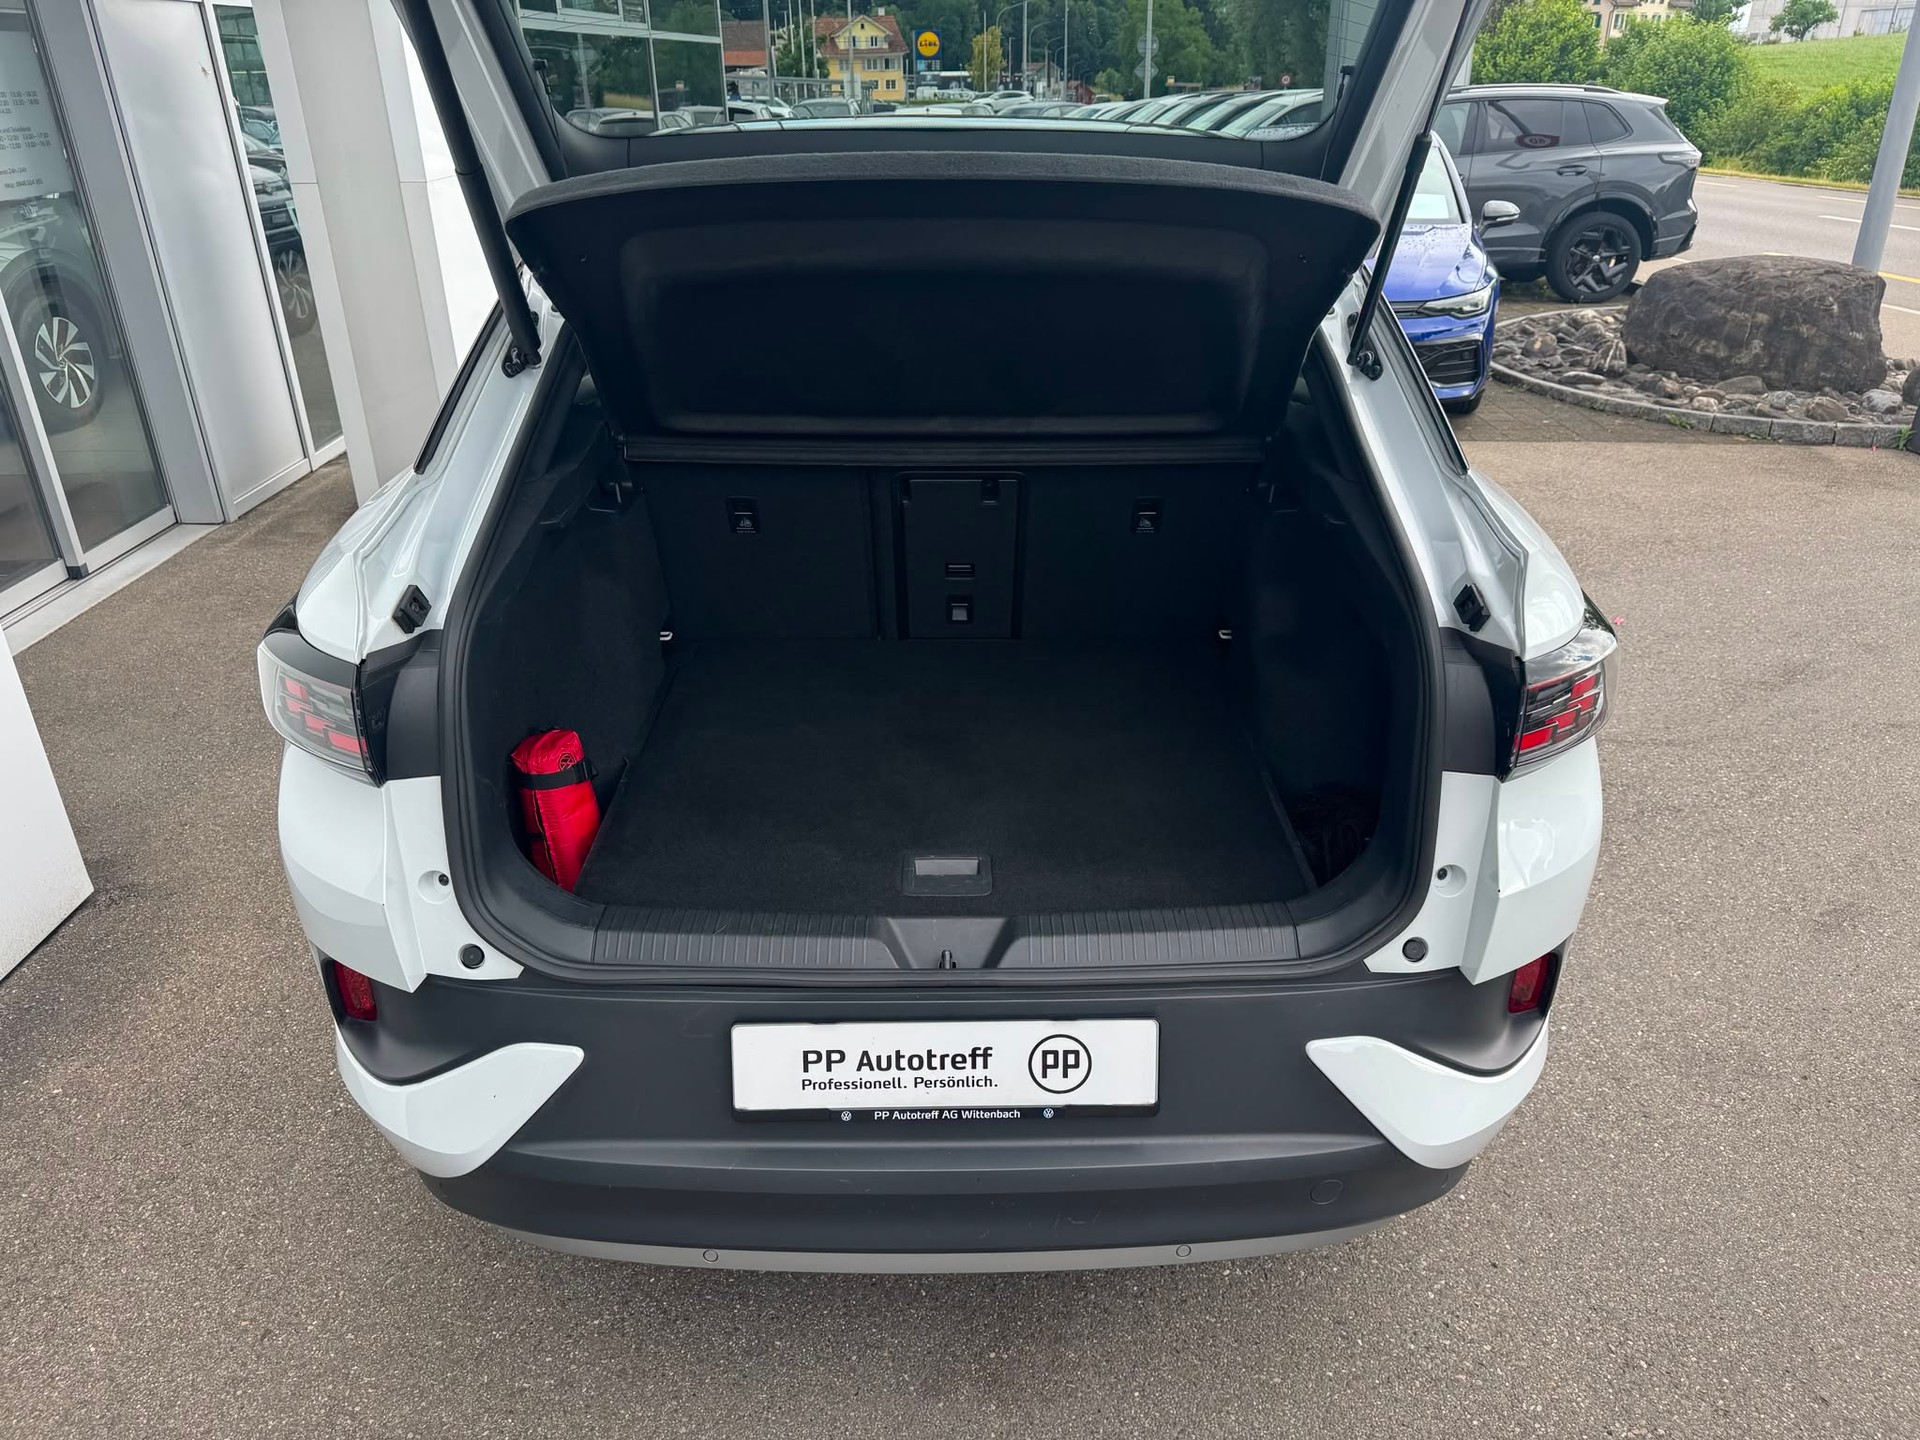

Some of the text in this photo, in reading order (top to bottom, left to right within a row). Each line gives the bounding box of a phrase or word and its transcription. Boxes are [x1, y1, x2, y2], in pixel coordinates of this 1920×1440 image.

[802, 1046, 993, 1073] PP Autotreff
[1041, 1049, 1080, 1079] PP
[801, 1075, 999, 1091] Professionell. Persönlich.
[873, 1109, 1021, 1120] PP Autotreff AG Wittenbach
